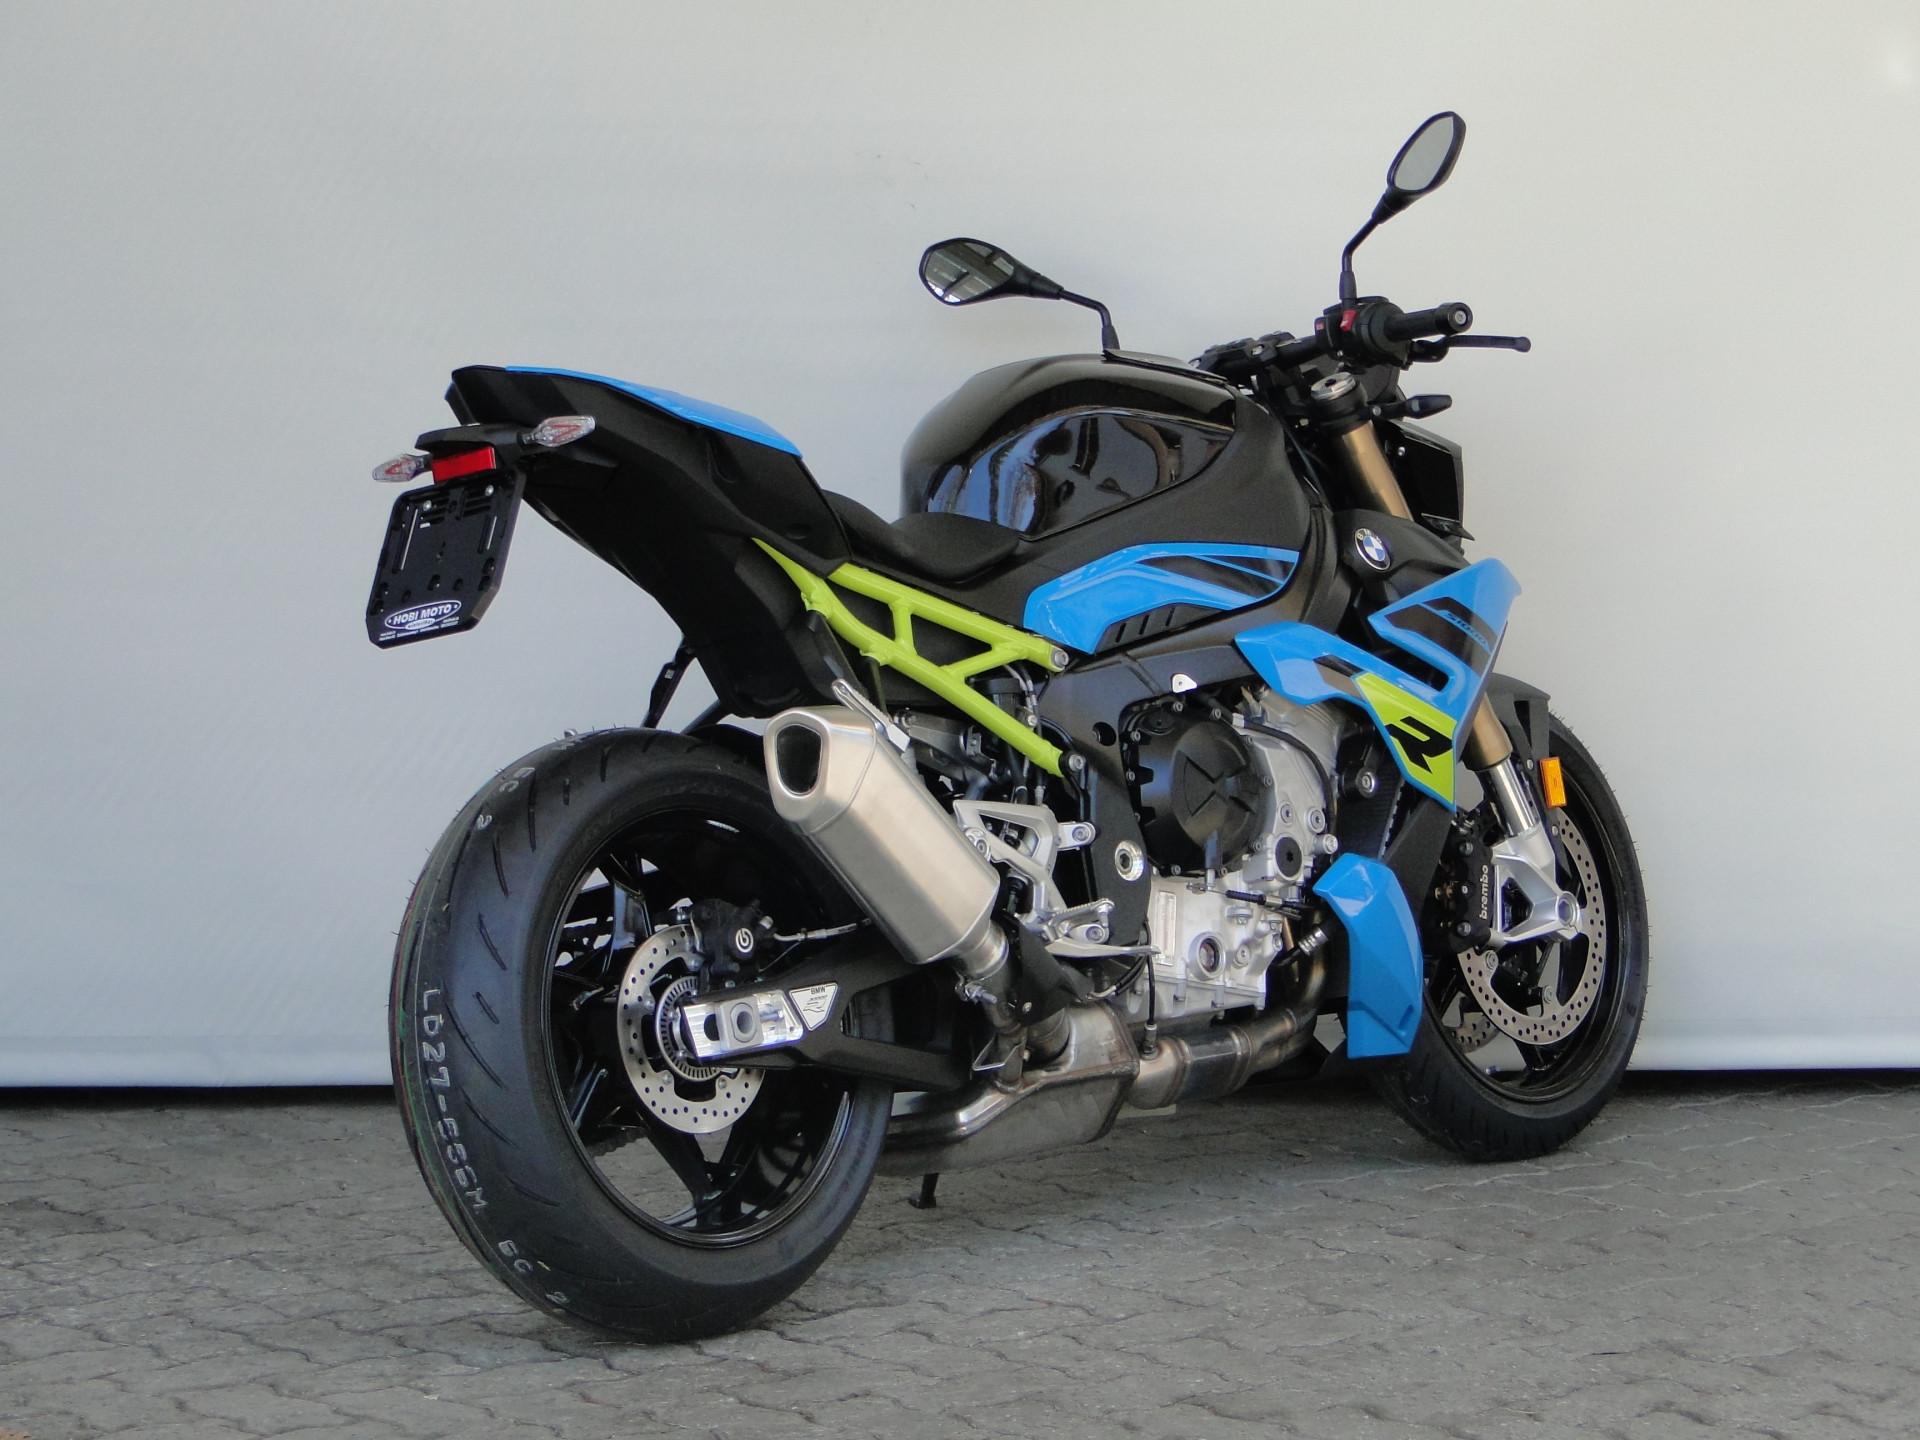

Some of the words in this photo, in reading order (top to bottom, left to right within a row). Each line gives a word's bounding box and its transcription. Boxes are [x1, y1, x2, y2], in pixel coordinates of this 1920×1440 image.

[393, 611, 419, 625] HOBI
[420, 604, 452, 618] MOTO
[1385, 716, 1453, 774] R
[1479, 864, 1489, 920] brembo
[810, 986, 826, 995] BMW
